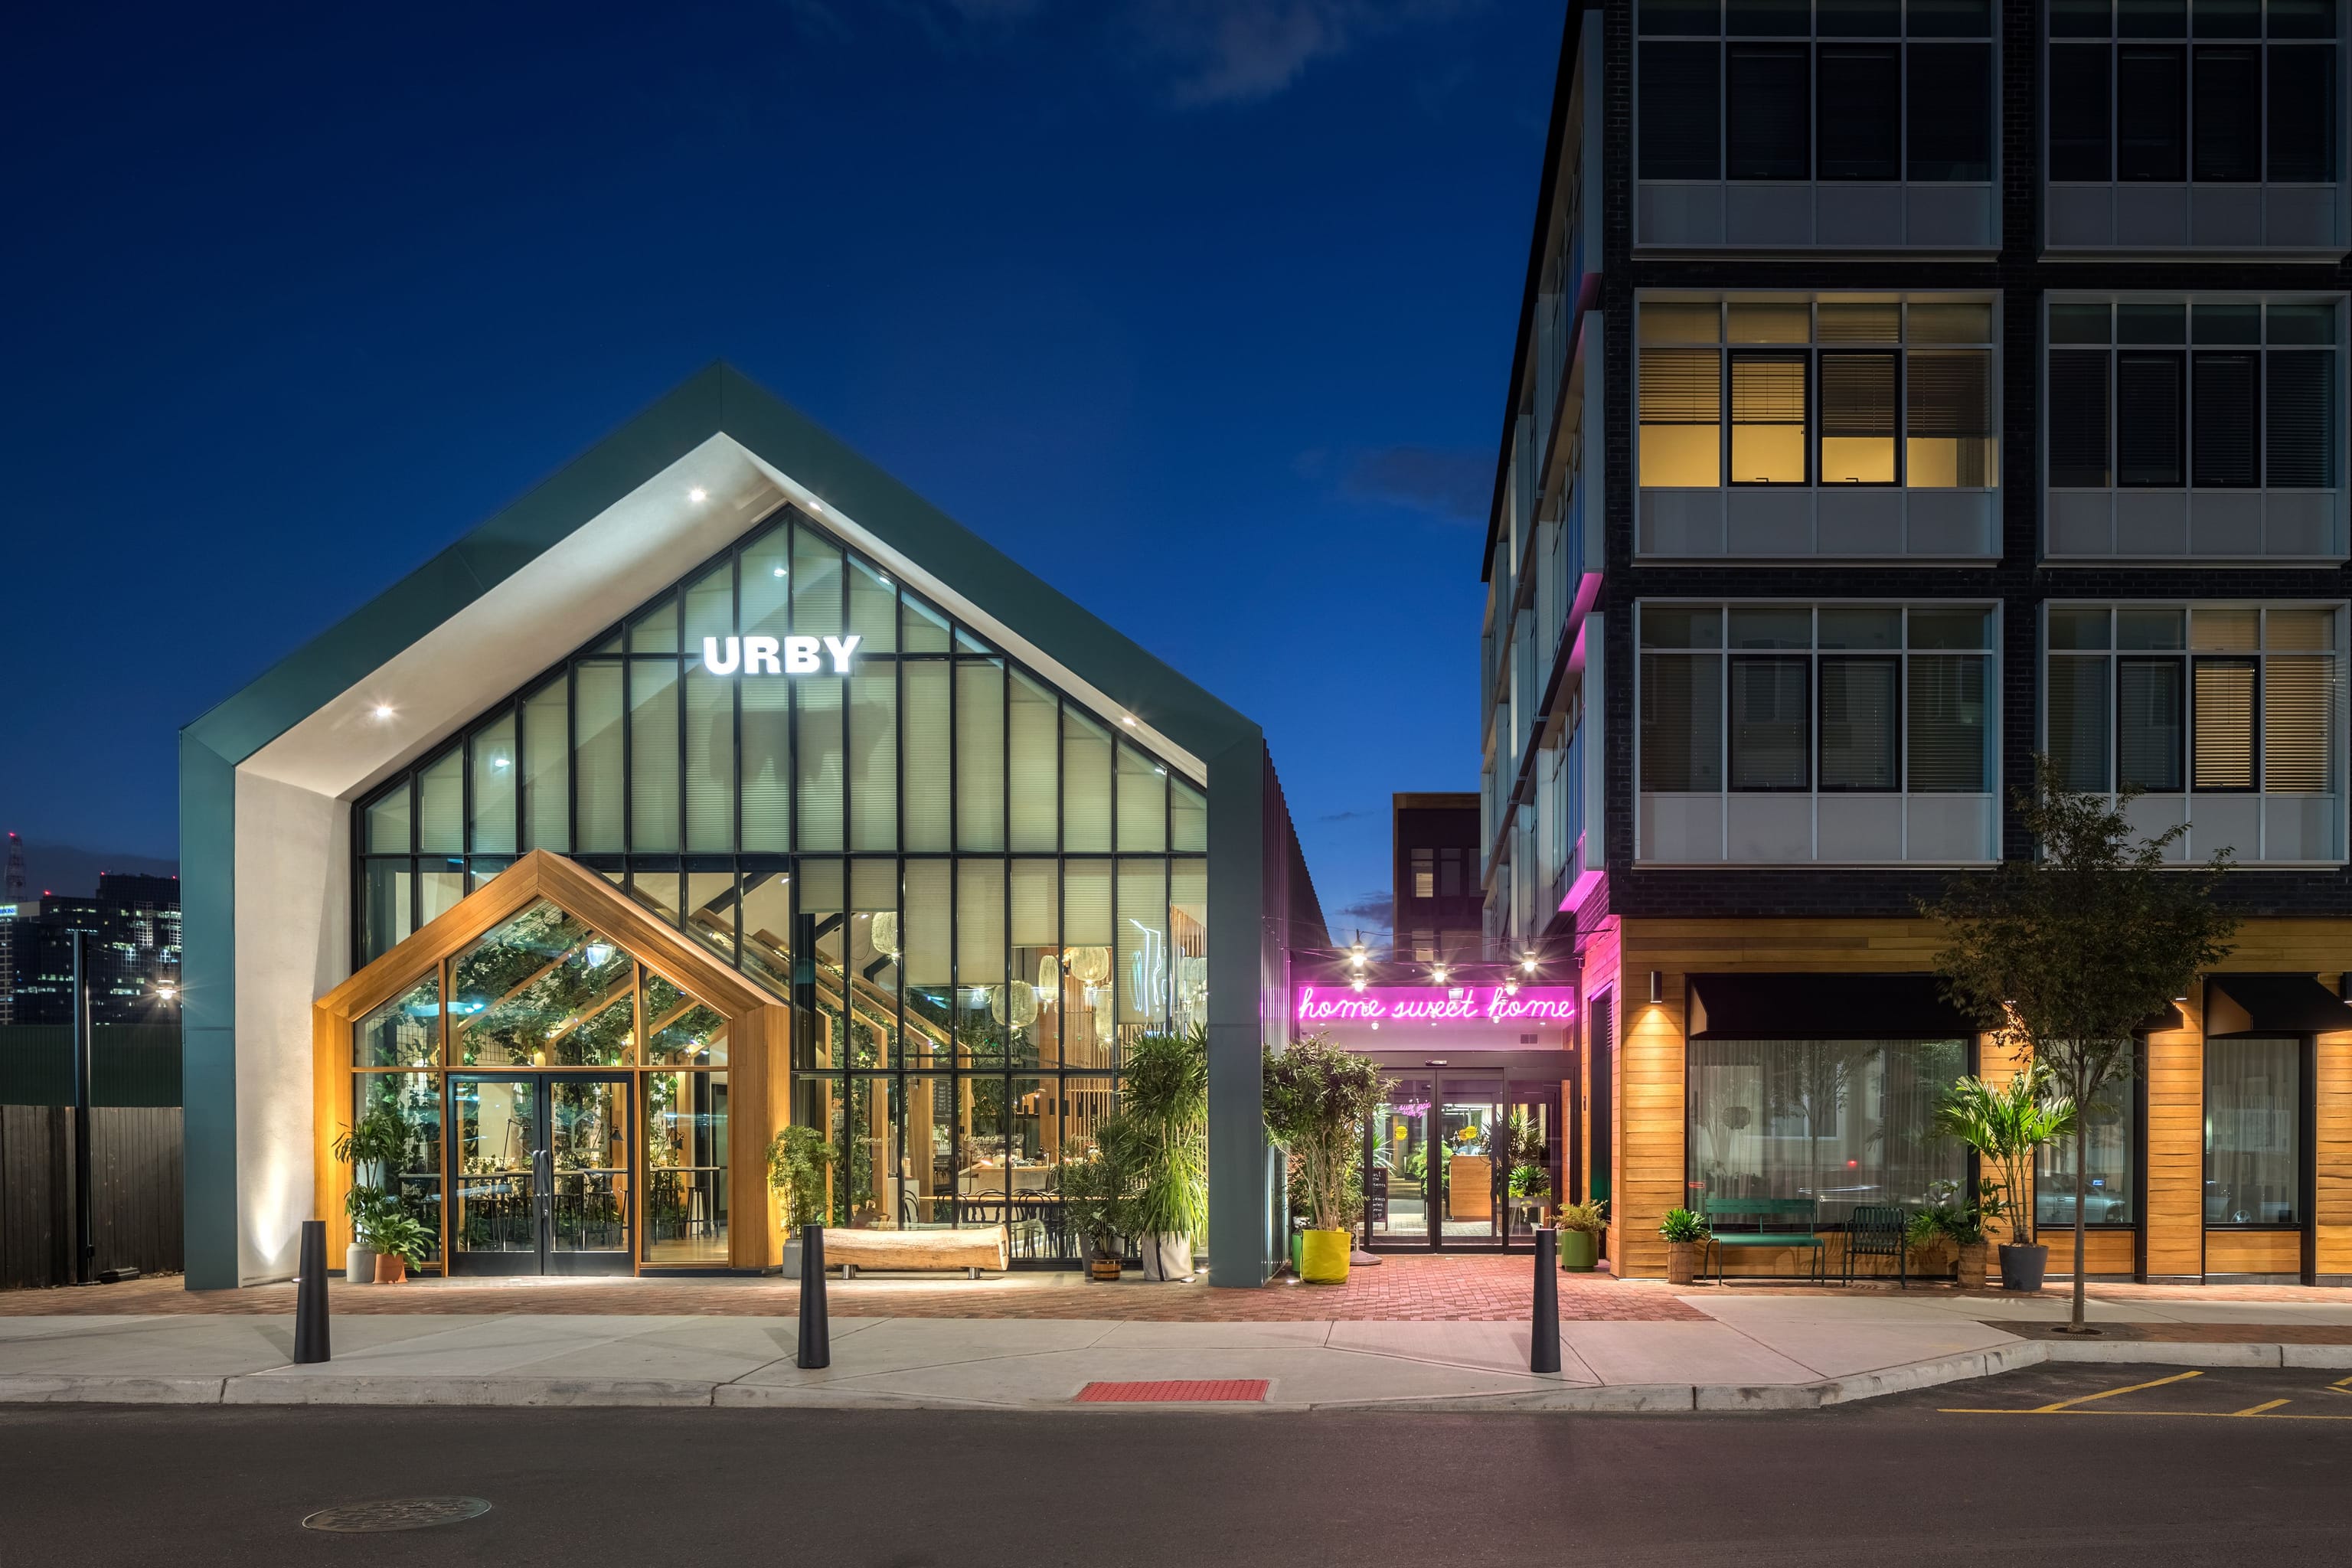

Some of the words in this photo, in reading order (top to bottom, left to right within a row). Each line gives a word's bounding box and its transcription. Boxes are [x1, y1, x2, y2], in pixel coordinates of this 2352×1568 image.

[703, 635, 864, 675] URBY
[1298, 988, 1386, 1019] home
[1391, 988, 1478, 1018] sweet
[1488, 987, 1576, 1018] home
